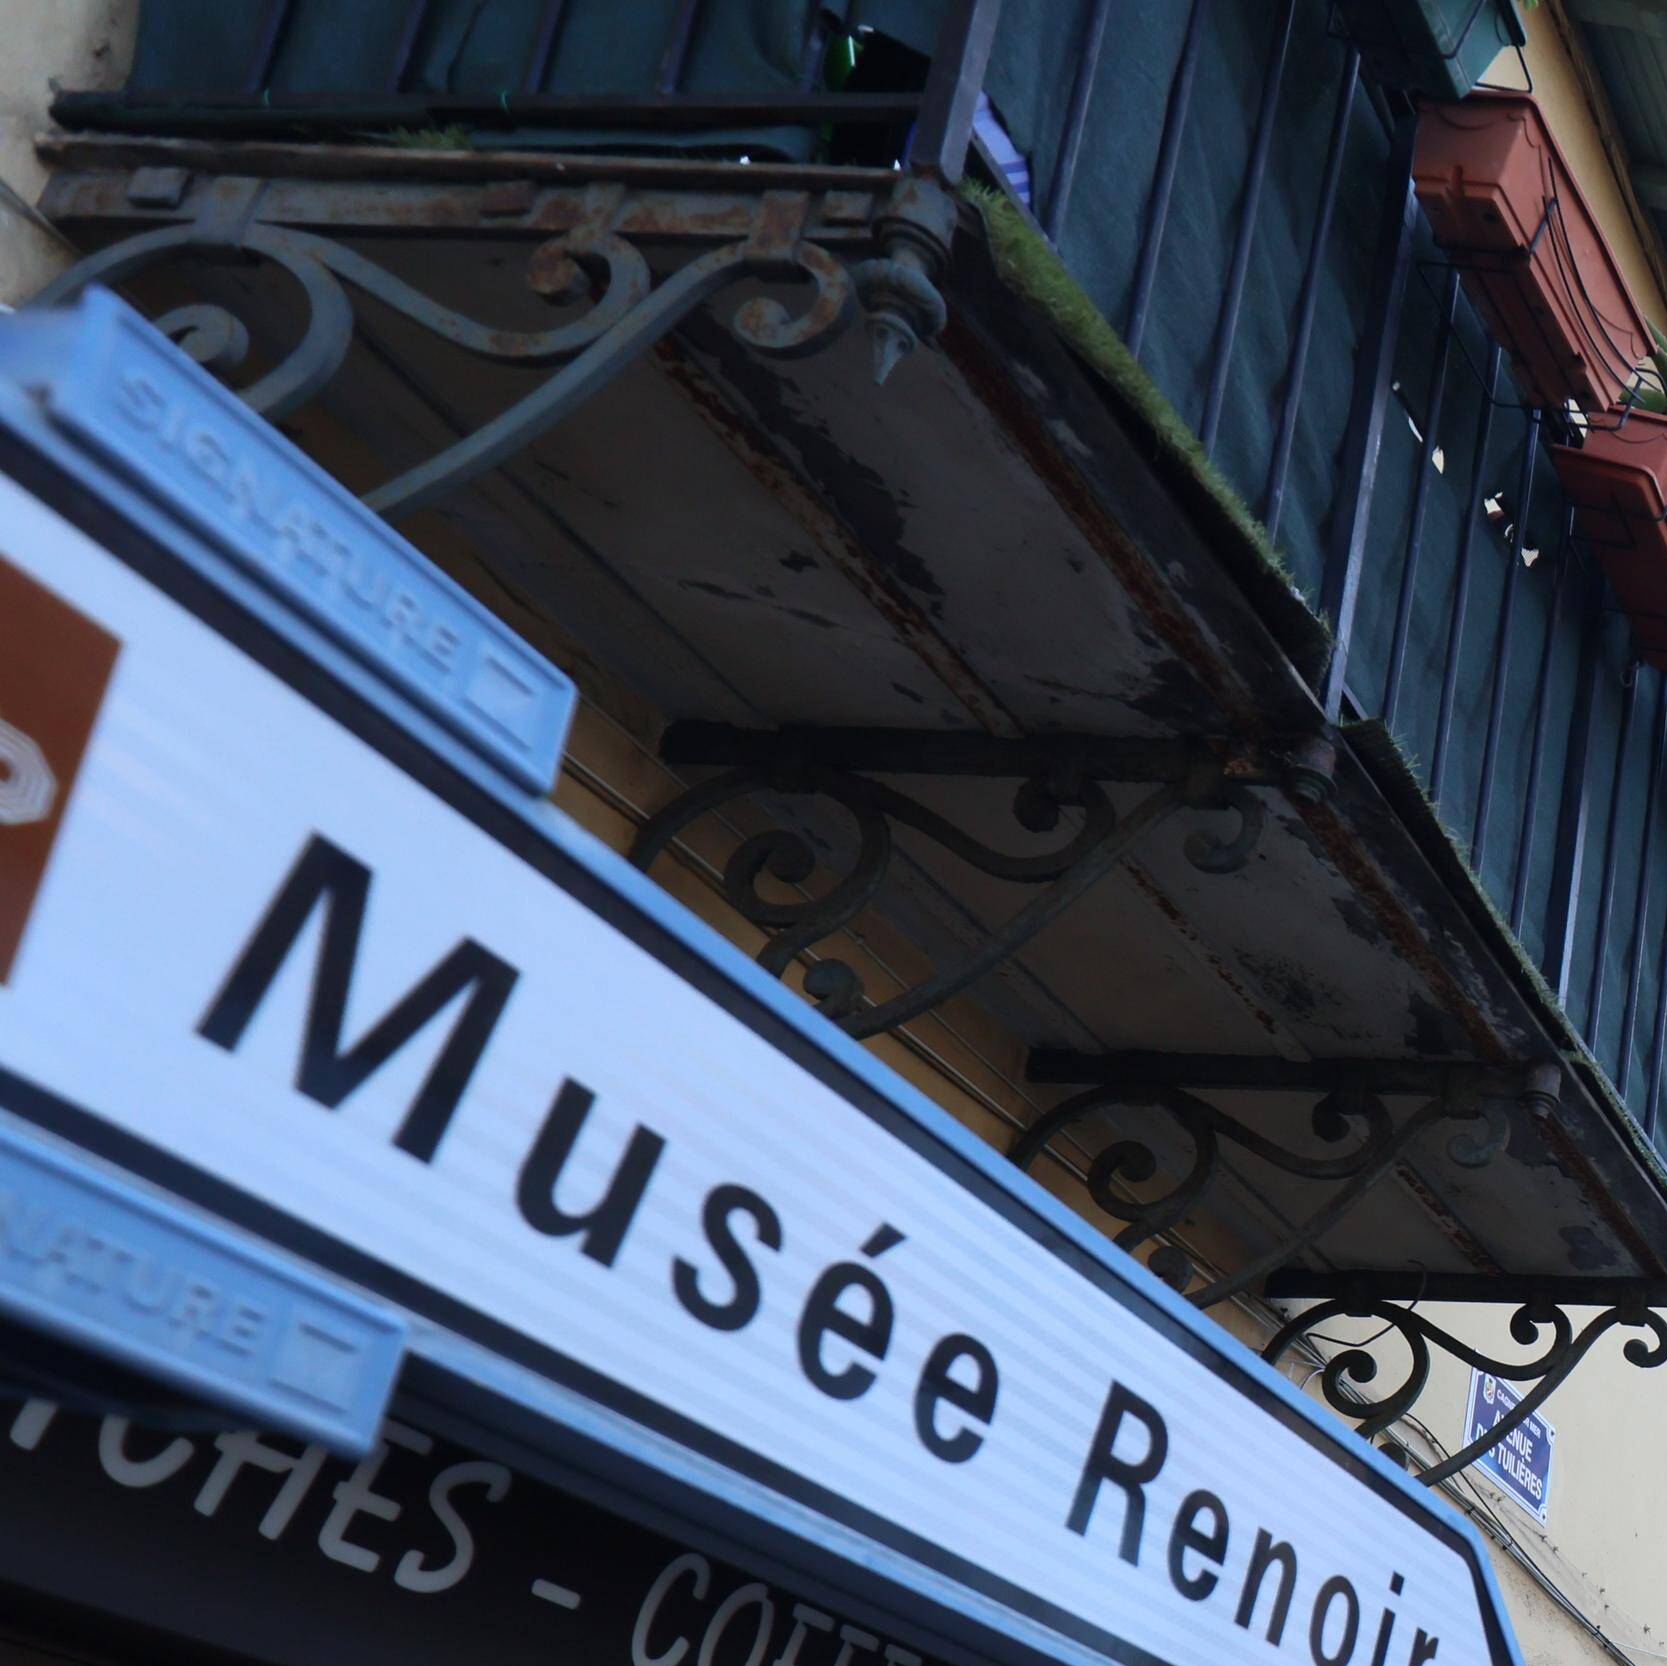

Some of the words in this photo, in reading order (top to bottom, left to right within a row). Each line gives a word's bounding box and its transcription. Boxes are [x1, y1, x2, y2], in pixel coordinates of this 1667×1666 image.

[194, 830, 1002, 1466] Musée
[1492, 1409, 1533, 1463] AENUE
[1497, 1441, 1543, 1501] TUILIÈRES
